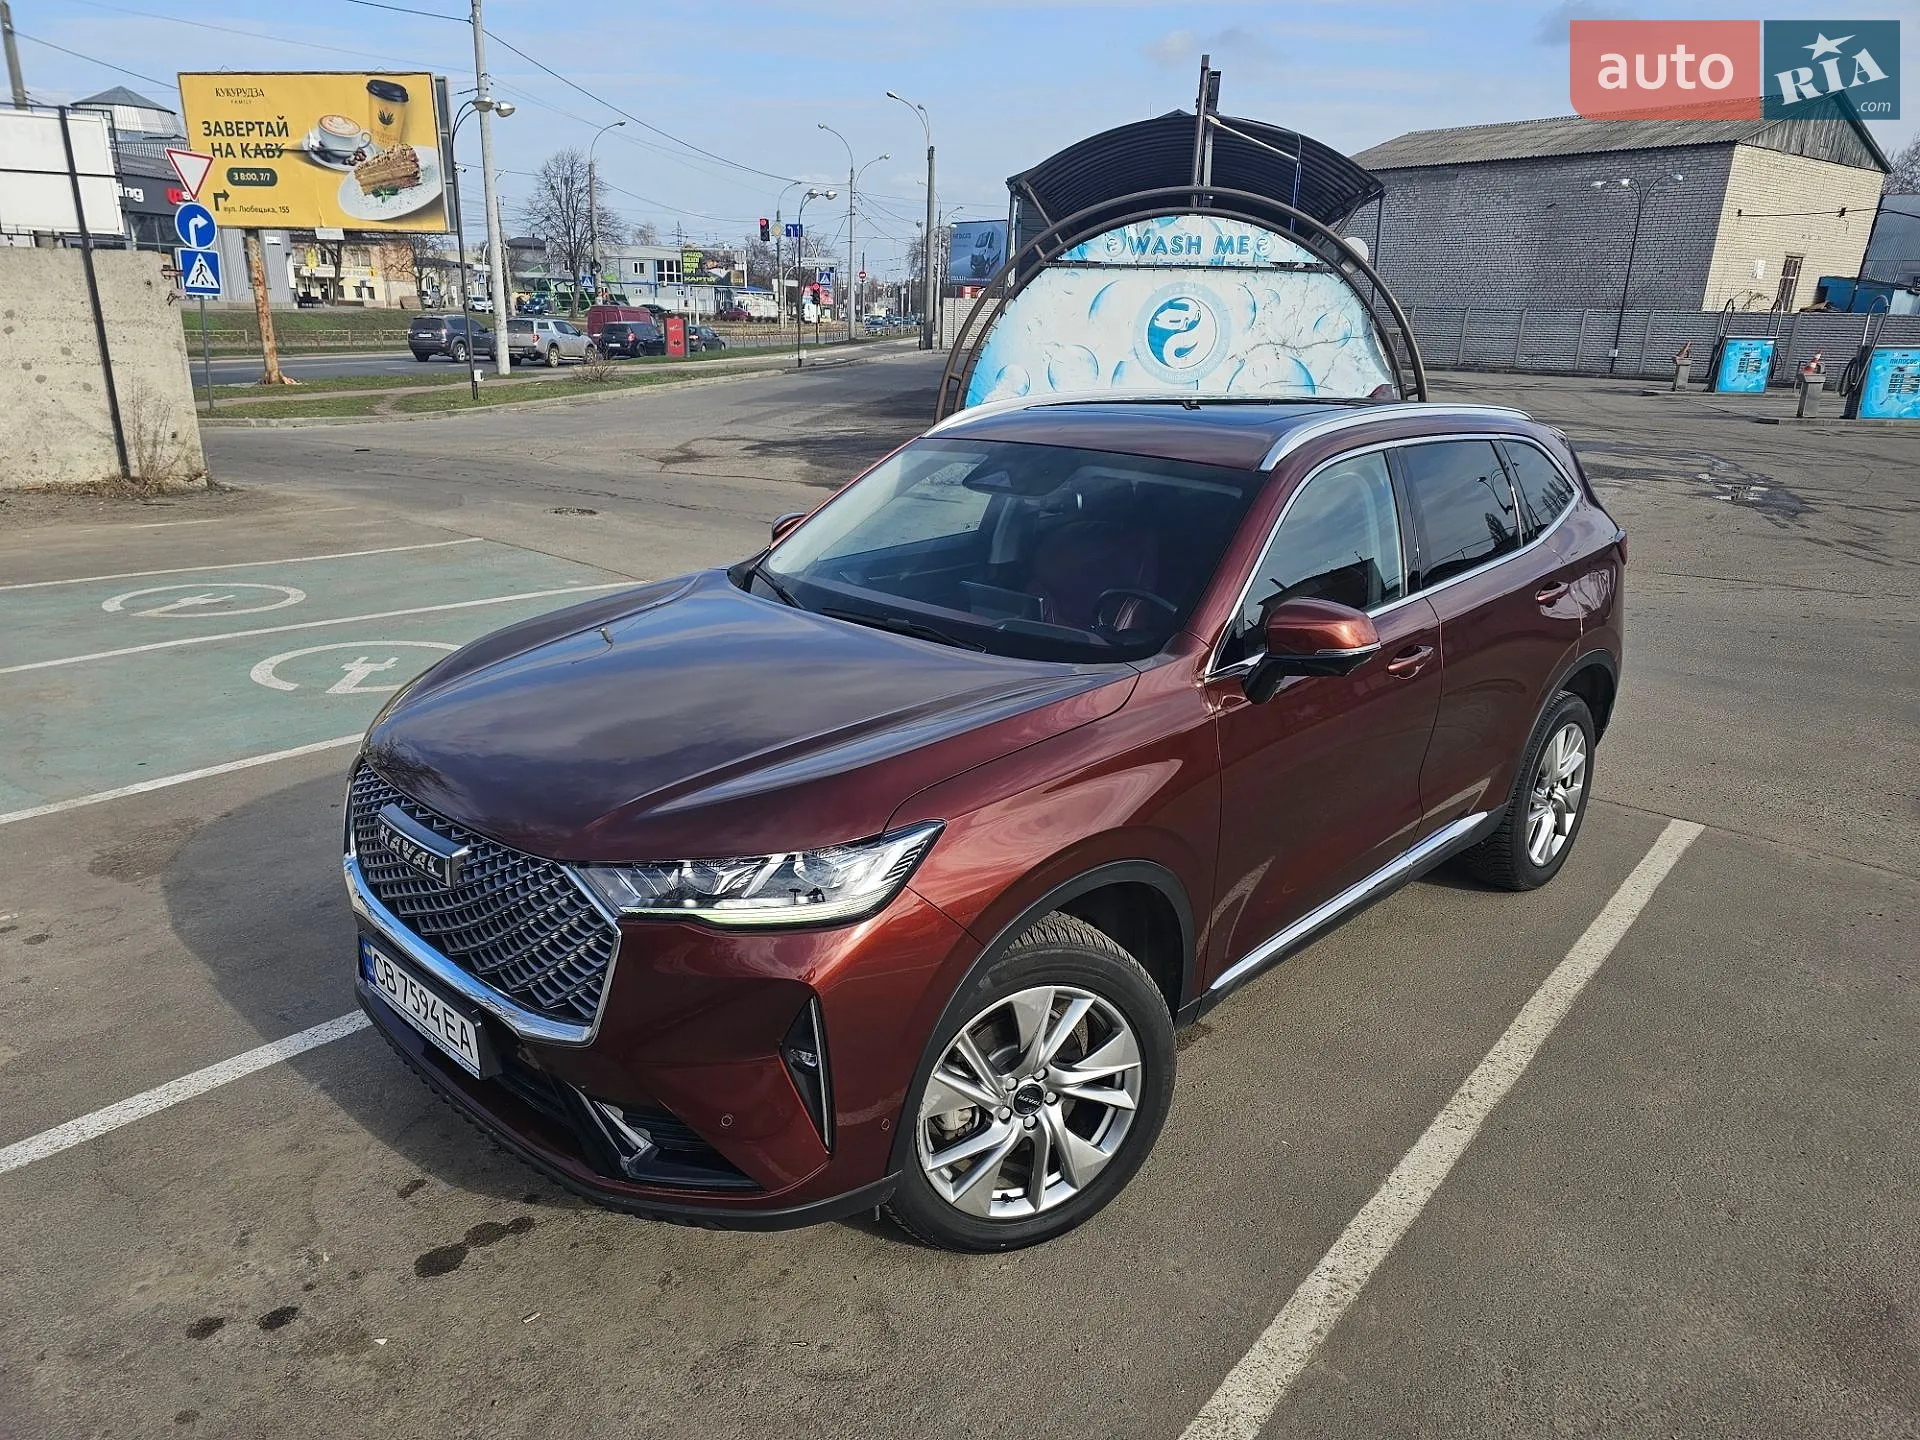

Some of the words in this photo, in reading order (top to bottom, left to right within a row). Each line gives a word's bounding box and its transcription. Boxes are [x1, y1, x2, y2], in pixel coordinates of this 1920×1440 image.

[215, 87, 265, 98] КУКУРУДЗА
[201, 115, 289, 137] ЗАВЕРТАЙ
[210, 142, 237, 158] НА
[239, 142, 285, 159] КАВУ
[1127, 234, 1203, 256] WASH
[1212, 234, 1251, 256] ME
[380, 824, 444, 878] HAVAL
[374, 953, 397, 995] CB
[398, 971, 442, 1034] 7594
[442, 1006, 474, 1059] EA
[1018, 1094, 1041, 1106] HAVAL
